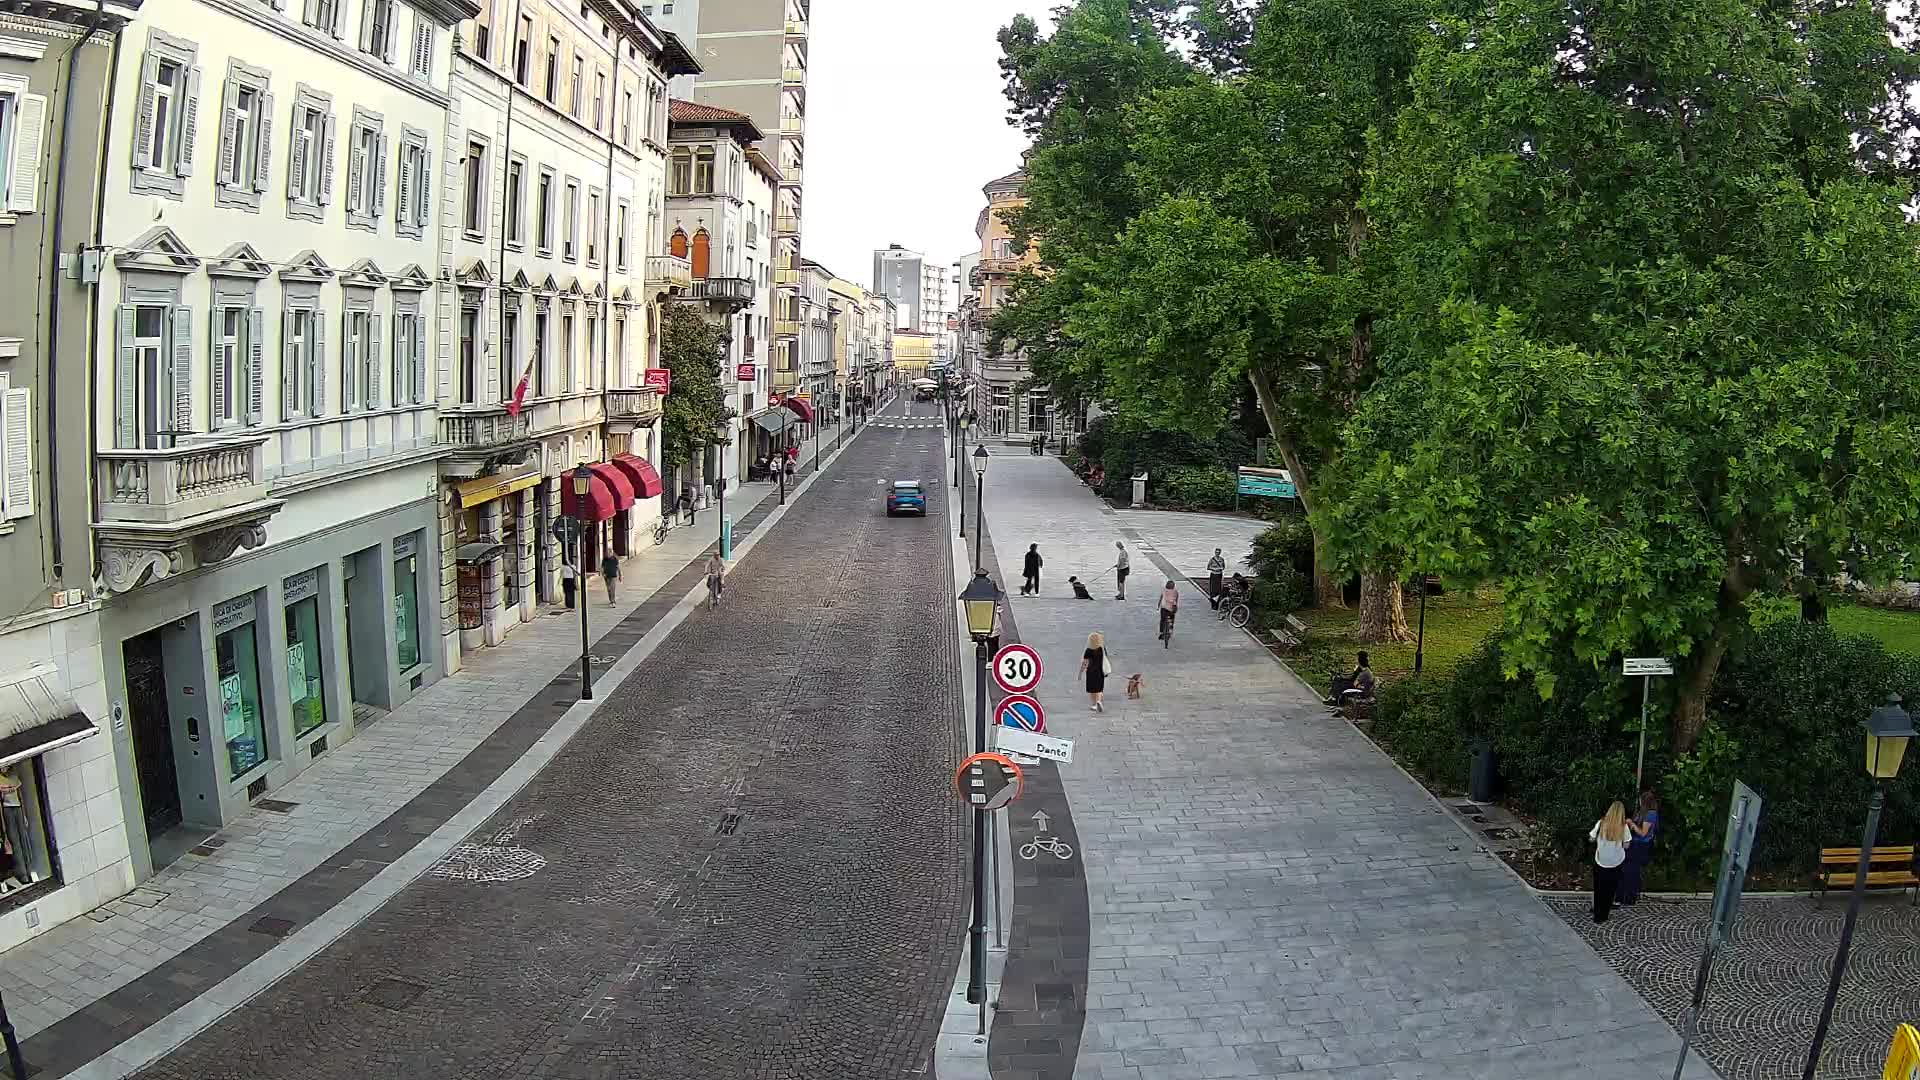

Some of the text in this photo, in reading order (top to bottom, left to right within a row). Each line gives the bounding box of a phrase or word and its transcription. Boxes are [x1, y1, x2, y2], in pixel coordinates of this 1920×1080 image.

[1005, 658, 1031, 679] 30
[220, 677, 239, 700] 130
[1037, 743, 1067, 758] Dante
